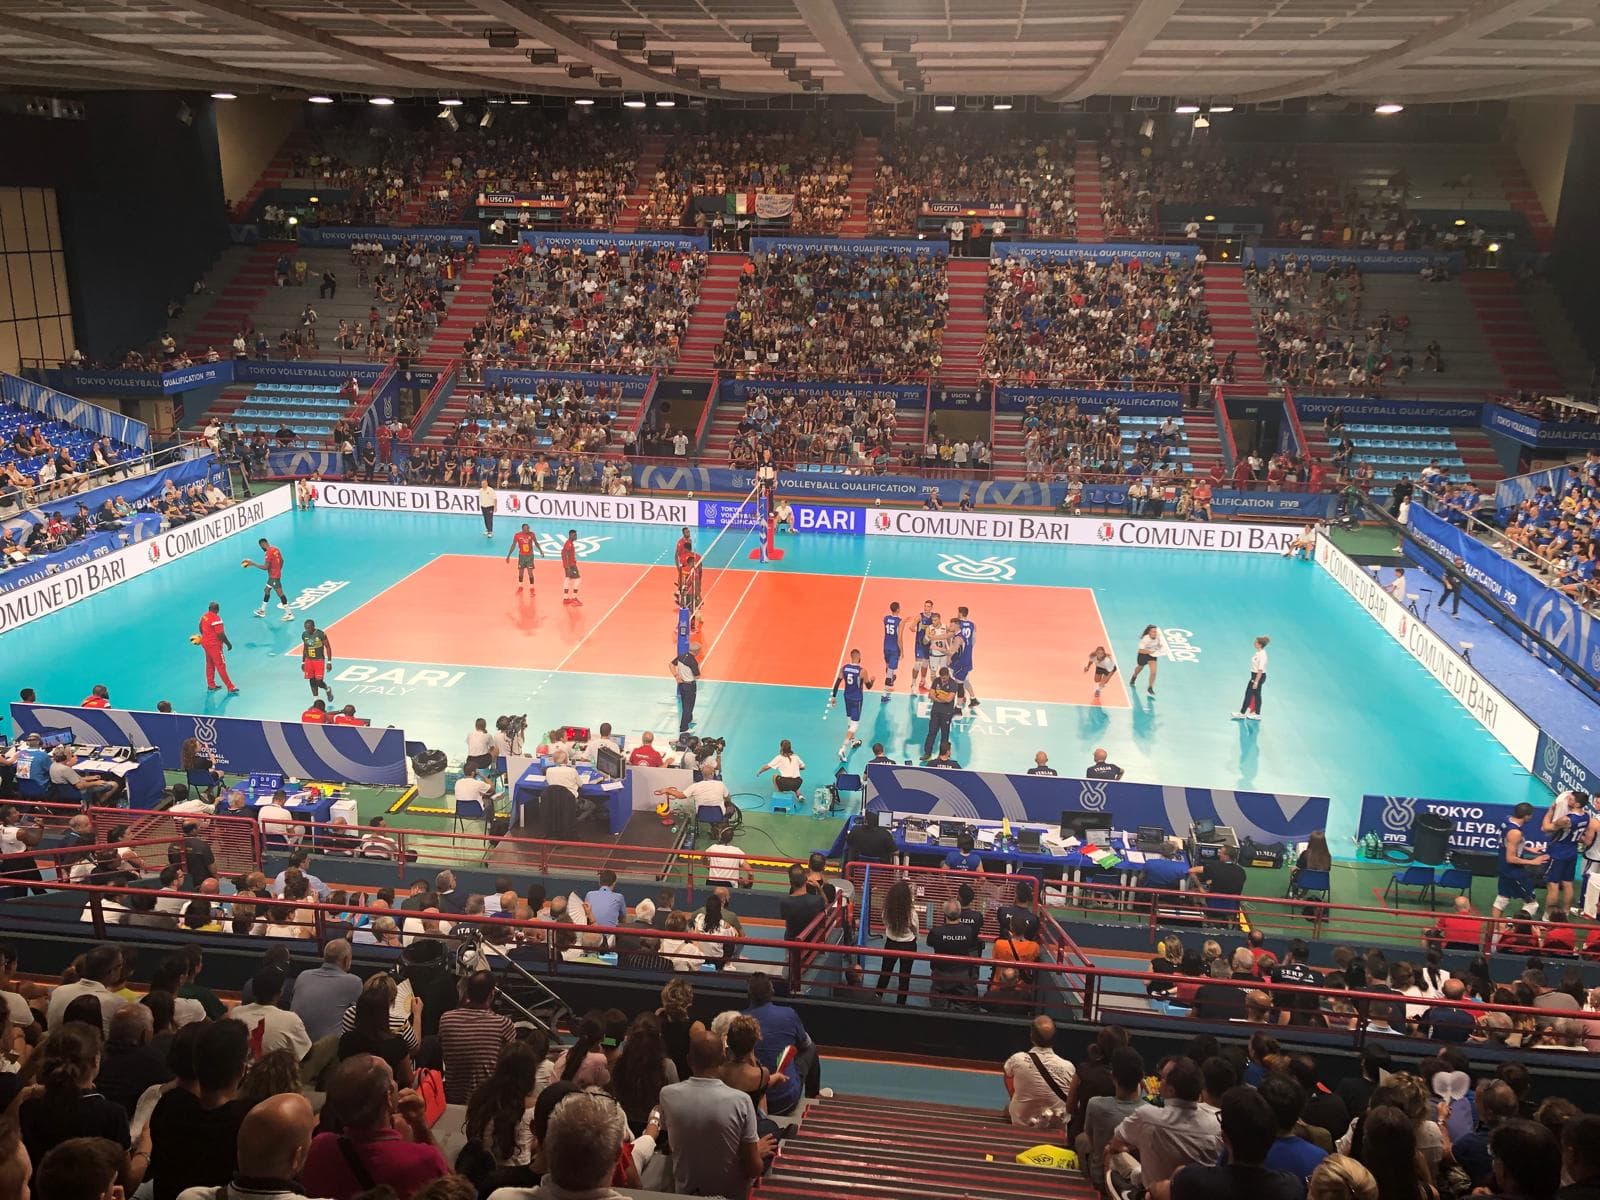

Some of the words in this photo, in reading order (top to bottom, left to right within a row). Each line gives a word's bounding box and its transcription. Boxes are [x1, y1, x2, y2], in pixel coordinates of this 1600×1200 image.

[250, 366, 276, 374] TOKYO
[278, 368, 328, 376] VOLLEYBALL
[76, 377, 105, 385] TOKYO
[108, 378, 162, 388] VOLLEYBALL
[163, 373, 204, 387] QUALIFICATION
[502, 376, 531, 384] TOKYO
[1400, 408, 1476, 416] QUALIFICATION
[780, 480, 840, 490] VOLLEYBALL
[842, 482, 916, 493] QUALIFICATION
[1280, 500, 1299, 508] FIVB
[800, 508, 855, 530] BARI
[886, 624, 894, 634] 15
[334, 665, 468, 688] BARI
[847, 674, 854, 684] 5
[348, 685, 417, 696] ITALY
[1563, 755, 1586, 781] TOKYO
[1426, 805, 1484, 819] TOKYO
[1384, 834, 1407, 842] FIVB
